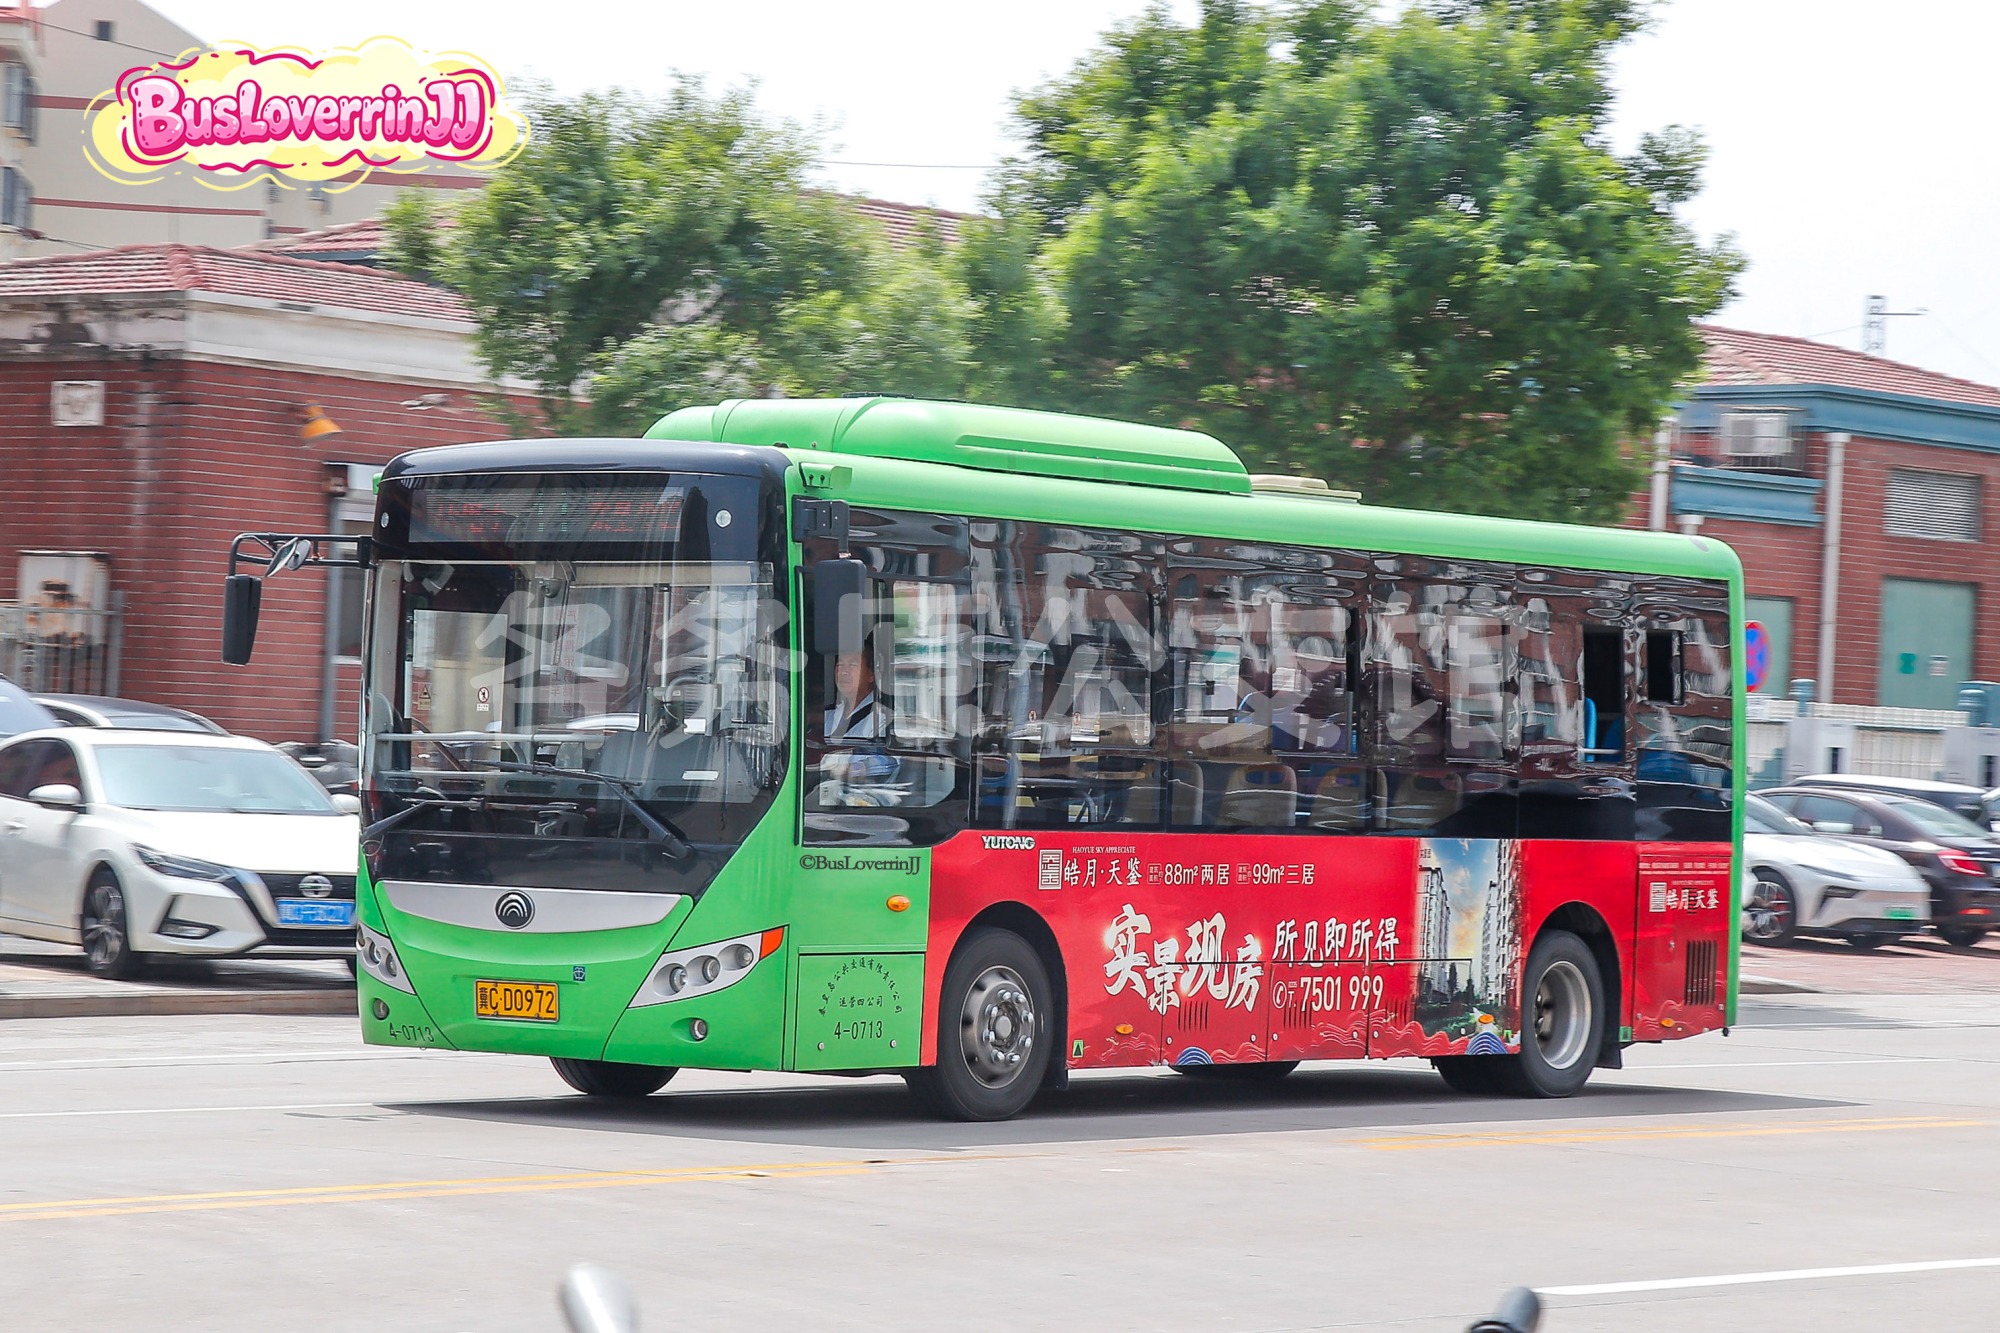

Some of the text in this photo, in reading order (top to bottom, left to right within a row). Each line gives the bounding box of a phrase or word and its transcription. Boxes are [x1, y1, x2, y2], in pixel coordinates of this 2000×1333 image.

[981, 835, 1036, 850] YUTONG
[1272, 917, 1400, 968] 所见即所得
[1103, 903, 1265, 1016] 实景现房
[1300, 976, 1342, 1012] 7501
[1349, 975, 1384, 1011] 999
[389, 1023, 434, 1043] 4-0713
[834, 1020, 883, 1040] 4-0713
